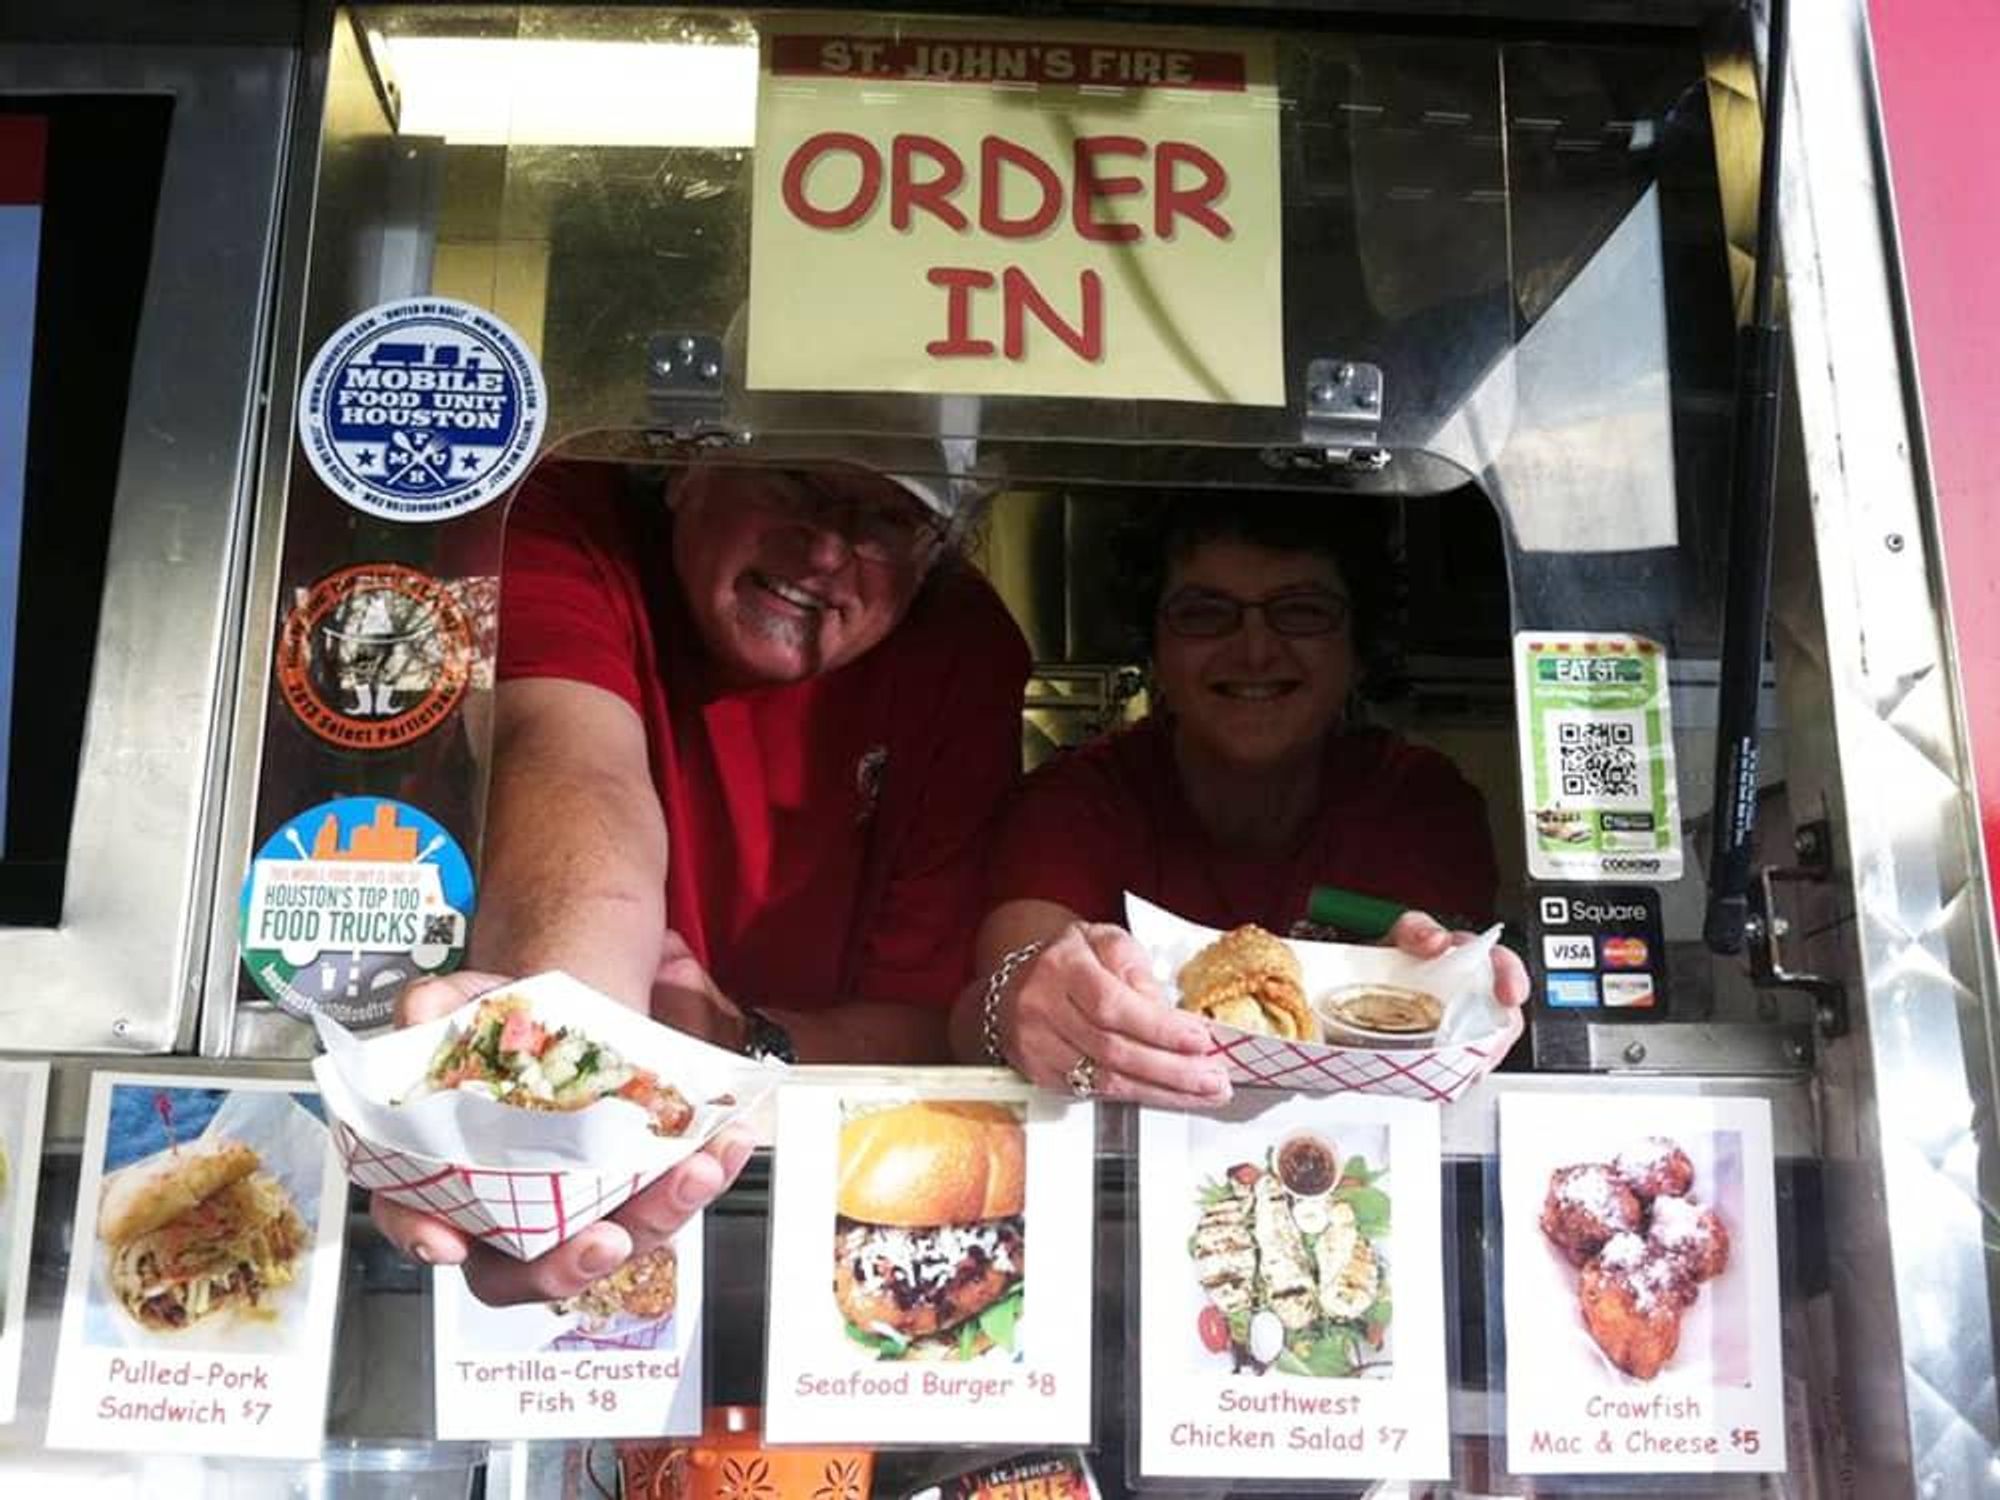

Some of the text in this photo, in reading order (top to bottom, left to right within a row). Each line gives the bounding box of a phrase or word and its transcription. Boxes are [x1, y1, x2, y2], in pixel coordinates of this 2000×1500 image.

[821, 41, 1196, 83] ST. JOHN'S FIRE
[782, 131, 1236, 242] ORDER
[926, 265, 1104, 362] IN
[345, 368, 504, 393] MOBILE
[338, 390, 507, 411] FOOD UNIT
[340, 408, 502, 430] HOUSTON
[414, 433, 429, 446] F
[432, 453, 446, 466] U
[1556, 659, 1590, 681] EAT
[319, 713, 372, 743] Select
[1601, 858, 1662, 874] COOKING
[264, 883, 421, 911] HOUSTON'S TOP 100
[1572, 900, 1647, 923] Square
[260, 908, 418, 946] FOOD TRUCKS
[1553, 944, 1592, 961] VISA
[109, 1356, 269, 1390] Pulled-Pork
[455, 1357, 681, 1383] Tortilla-Crusted
[795, 1370, 1056, 1403] Seafood Burger $8
[97, 1395, 273, 1425] Sandwich $7
[519, 1388, 619, 1415] Fish $8
[1217, 1388, 1362, 1415] Southwest
[1585, 1394, 1702, 1420] Crawfish
[1169, 1423, 1409, 1453] Chicken Salad $7
[1530, 1427, 1761, 1455] Mac & Cheese $5
